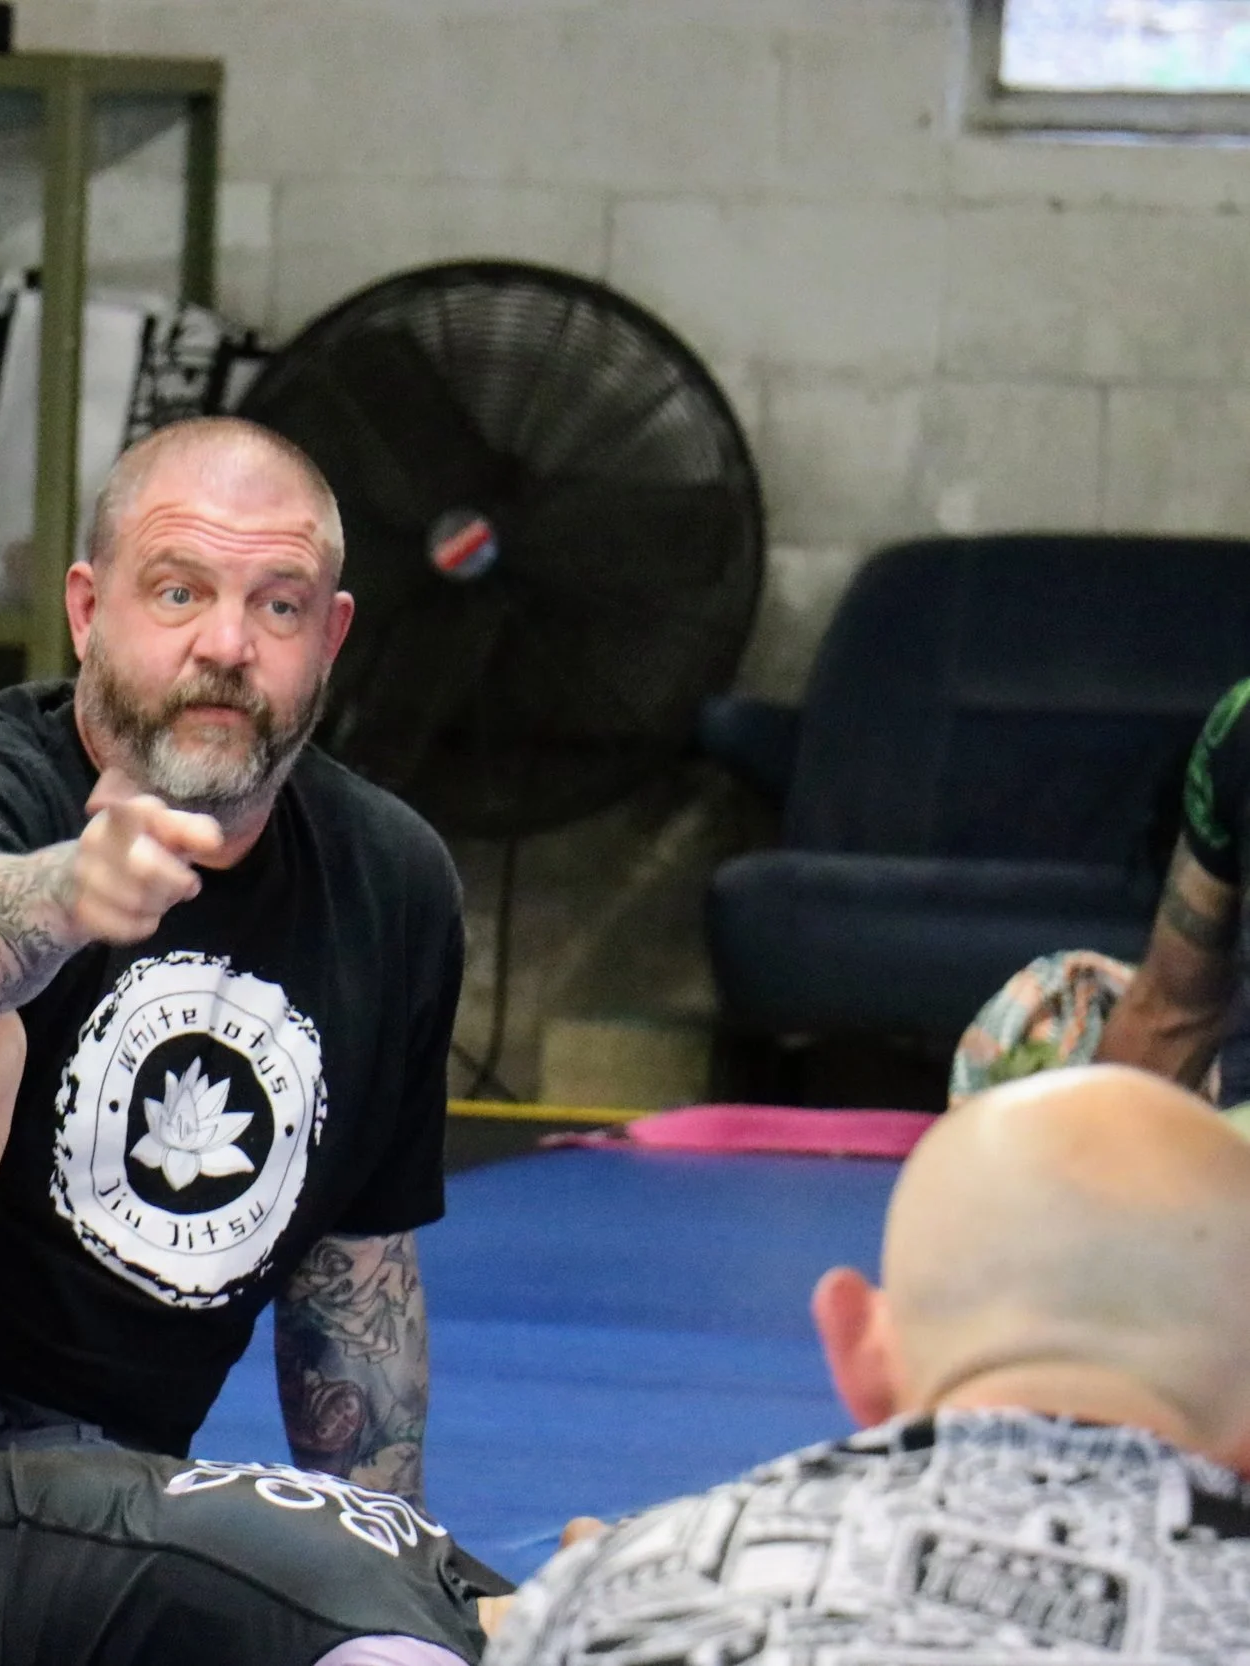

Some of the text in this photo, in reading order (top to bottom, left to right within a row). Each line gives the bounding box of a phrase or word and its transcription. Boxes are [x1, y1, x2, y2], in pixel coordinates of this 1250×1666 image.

[118, 1006, 288, 1095] White otus
[98, 1177, 264, 1250] Jiu Jitsu
